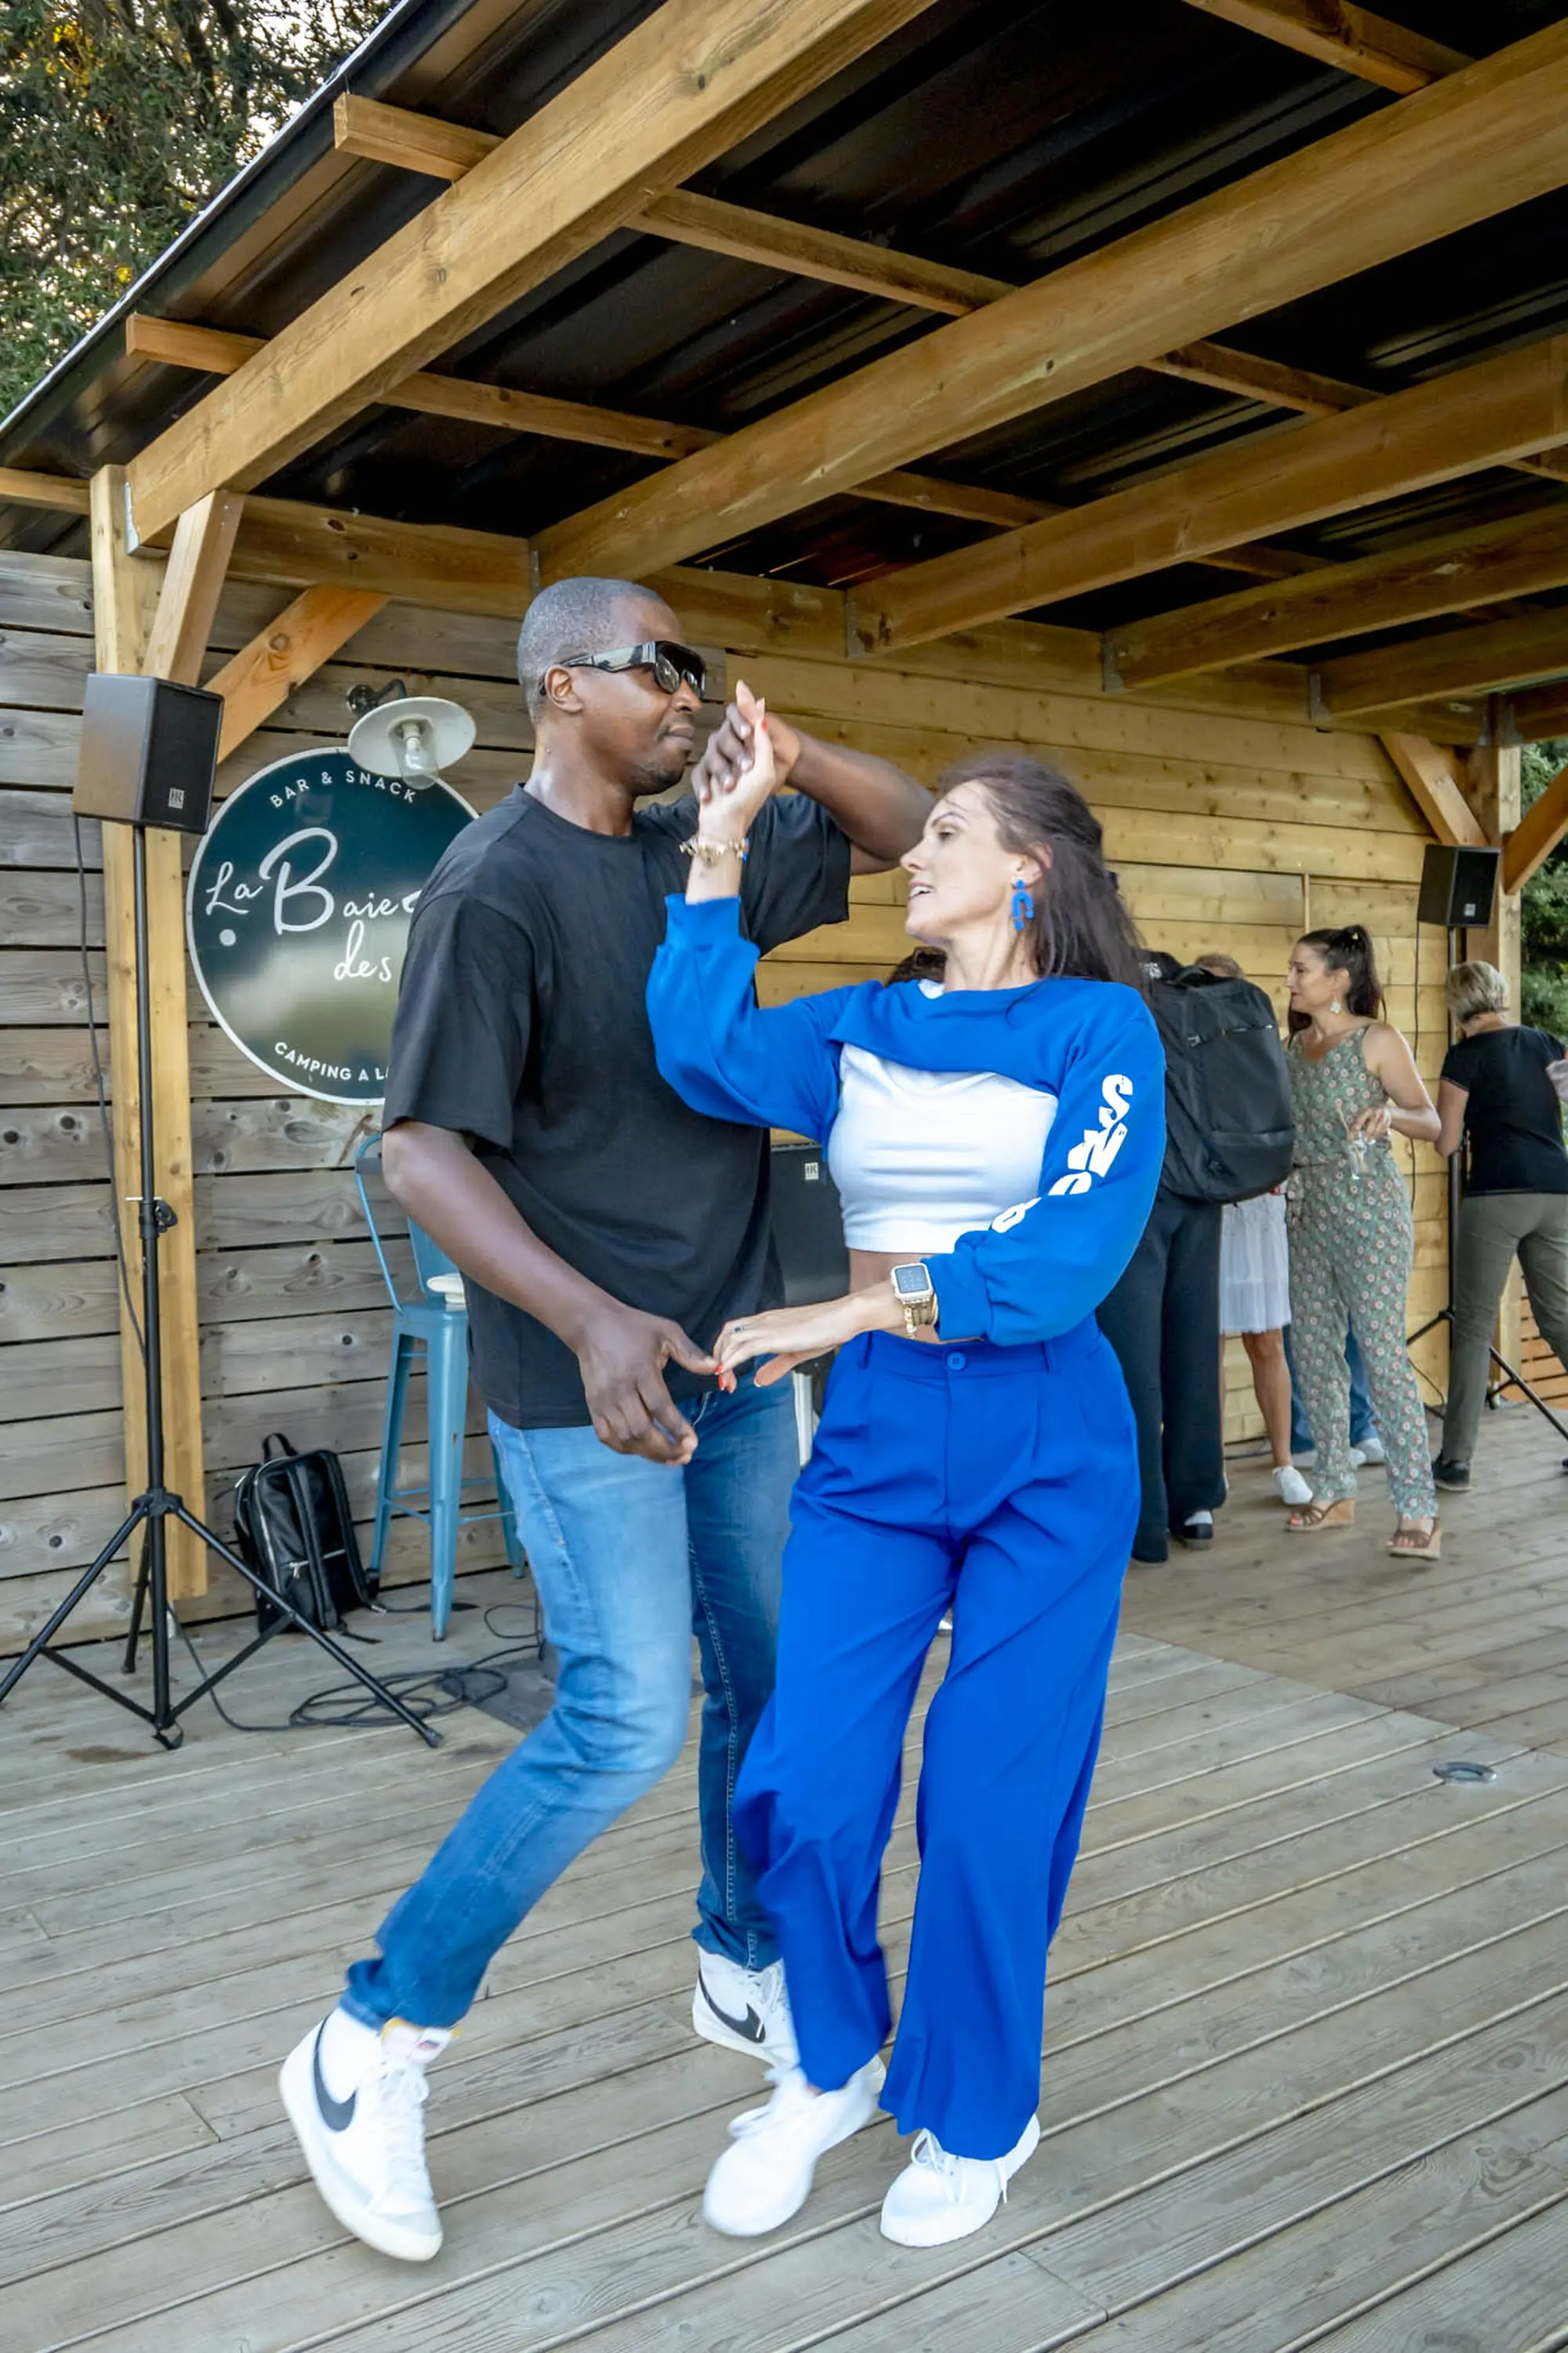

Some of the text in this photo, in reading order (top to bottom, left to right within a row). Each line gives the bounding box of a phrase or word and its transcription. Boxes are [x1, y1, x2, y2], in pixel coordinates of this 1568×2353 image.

[269, 770, 417, 808] BAR & SNACK
[205, 827, 399, 935] La Baie
[333, 919, 392, 982] des
[274, 1041, 352, 1081] CAMPING
[358, 1068, 369, 1082] A
